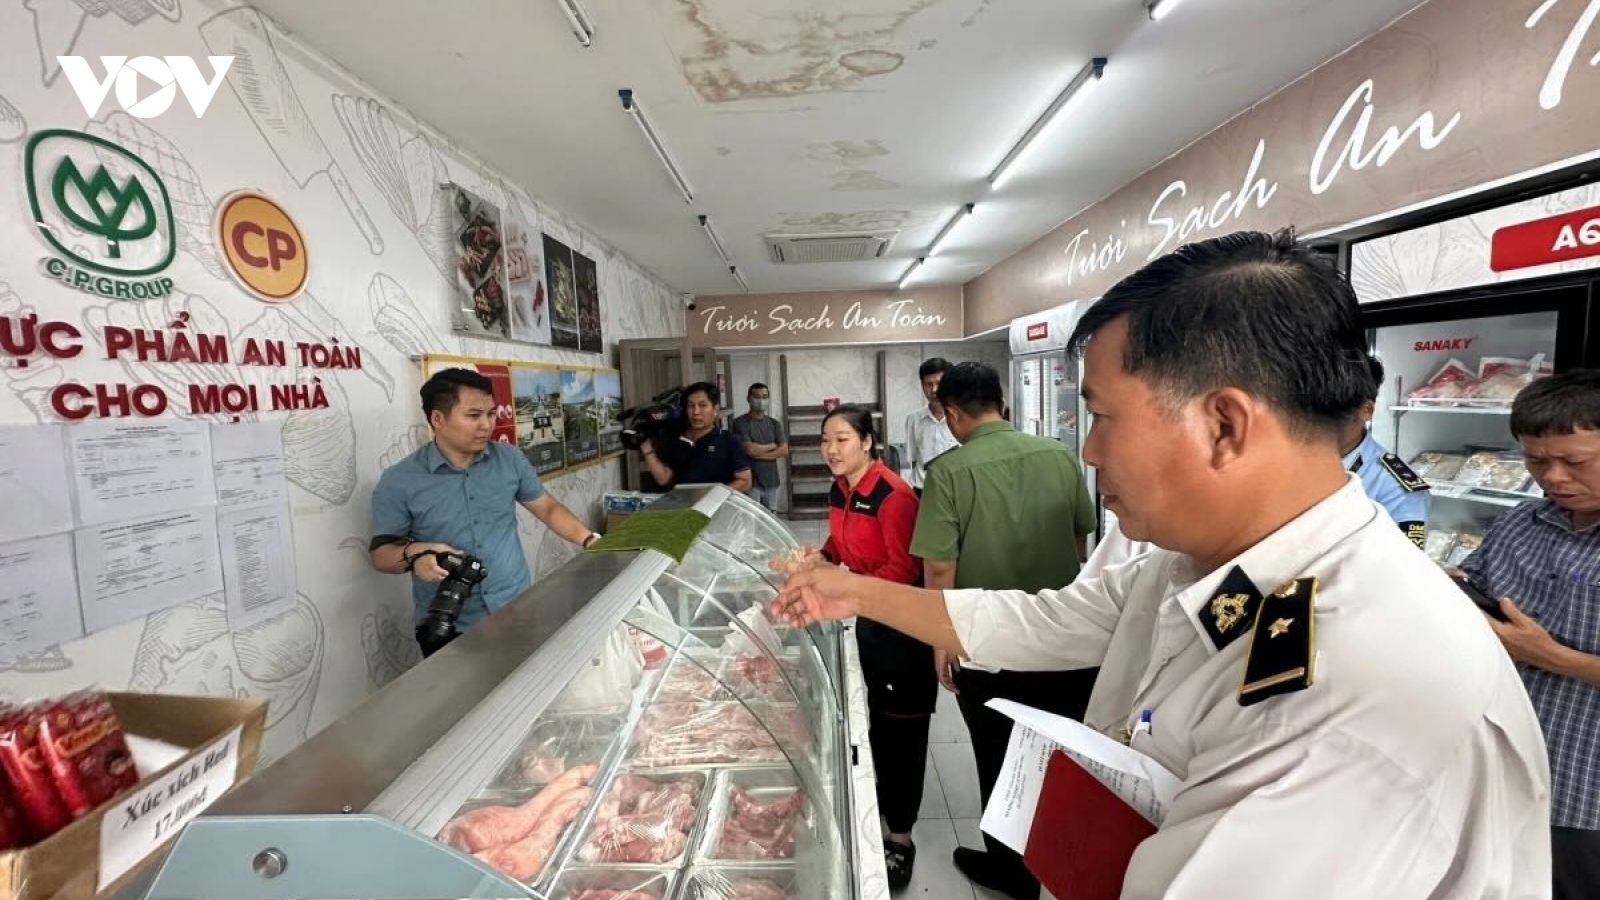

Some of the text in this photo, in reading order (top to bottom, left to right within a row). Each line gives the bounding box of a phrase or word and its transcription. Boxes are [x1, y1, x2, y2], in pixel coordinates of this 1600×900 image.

[1309, 79, 1461, 195] An
[231, 221, 297, 272] CP
[104, 311, 229, 363] PHẨM
[243, 338, 286, 366] AN
[297, 336, 362, 369] TOÀN
[768, 304, 834, 335] Sạch
[843, 302, 881, 330] An
[887, 299, 947, 328] Toàn
[1414, 337, 1473, 351] SANAKY
[51, 376, 330, 422] CHO MỌI NHÀ
[123, 790, 162, 830] Xúc
